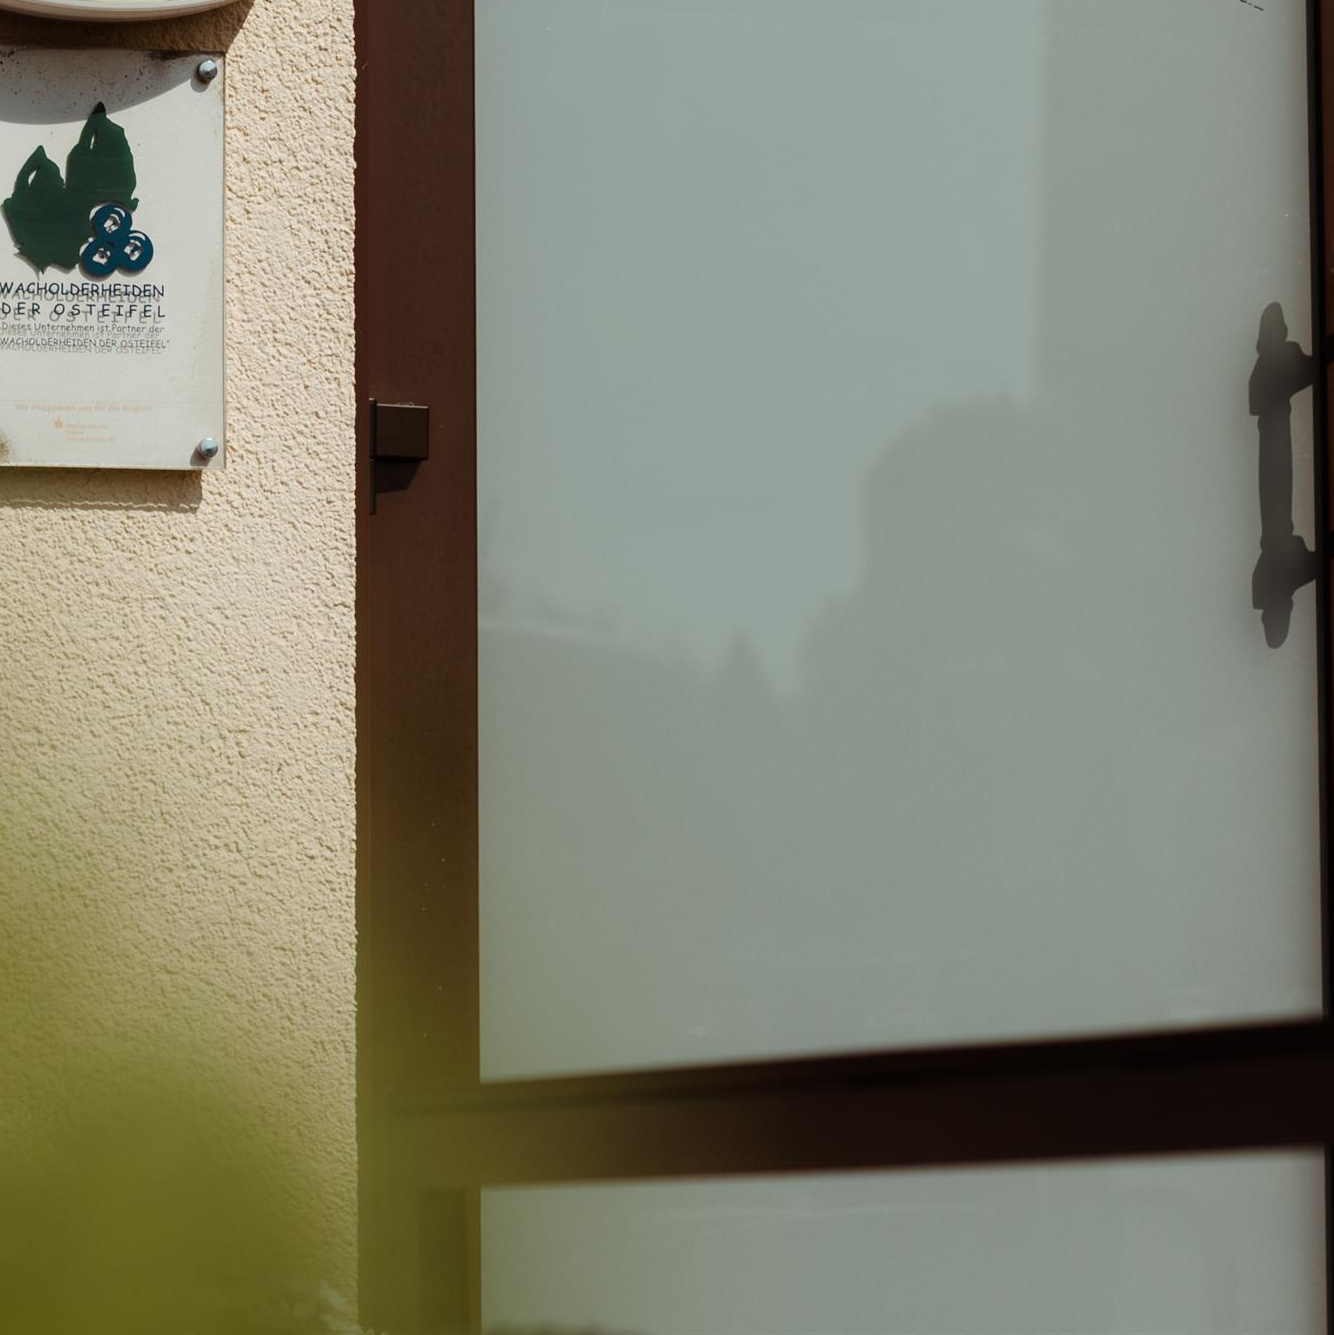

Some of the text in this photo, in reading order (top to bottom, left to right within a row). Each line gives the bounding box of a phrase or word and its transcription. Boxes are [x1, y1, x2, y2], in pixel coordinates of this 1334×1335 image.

[1, 302, 166, 318] DER OSTEIFEL
[1, 321, 32, 331] Dieses
[33, 322, 95, 333] Unternehmen
[111, 324, 146, 334] Partner
[148, 325, 165, 334] der
[98, 339, 117, 348] DER
